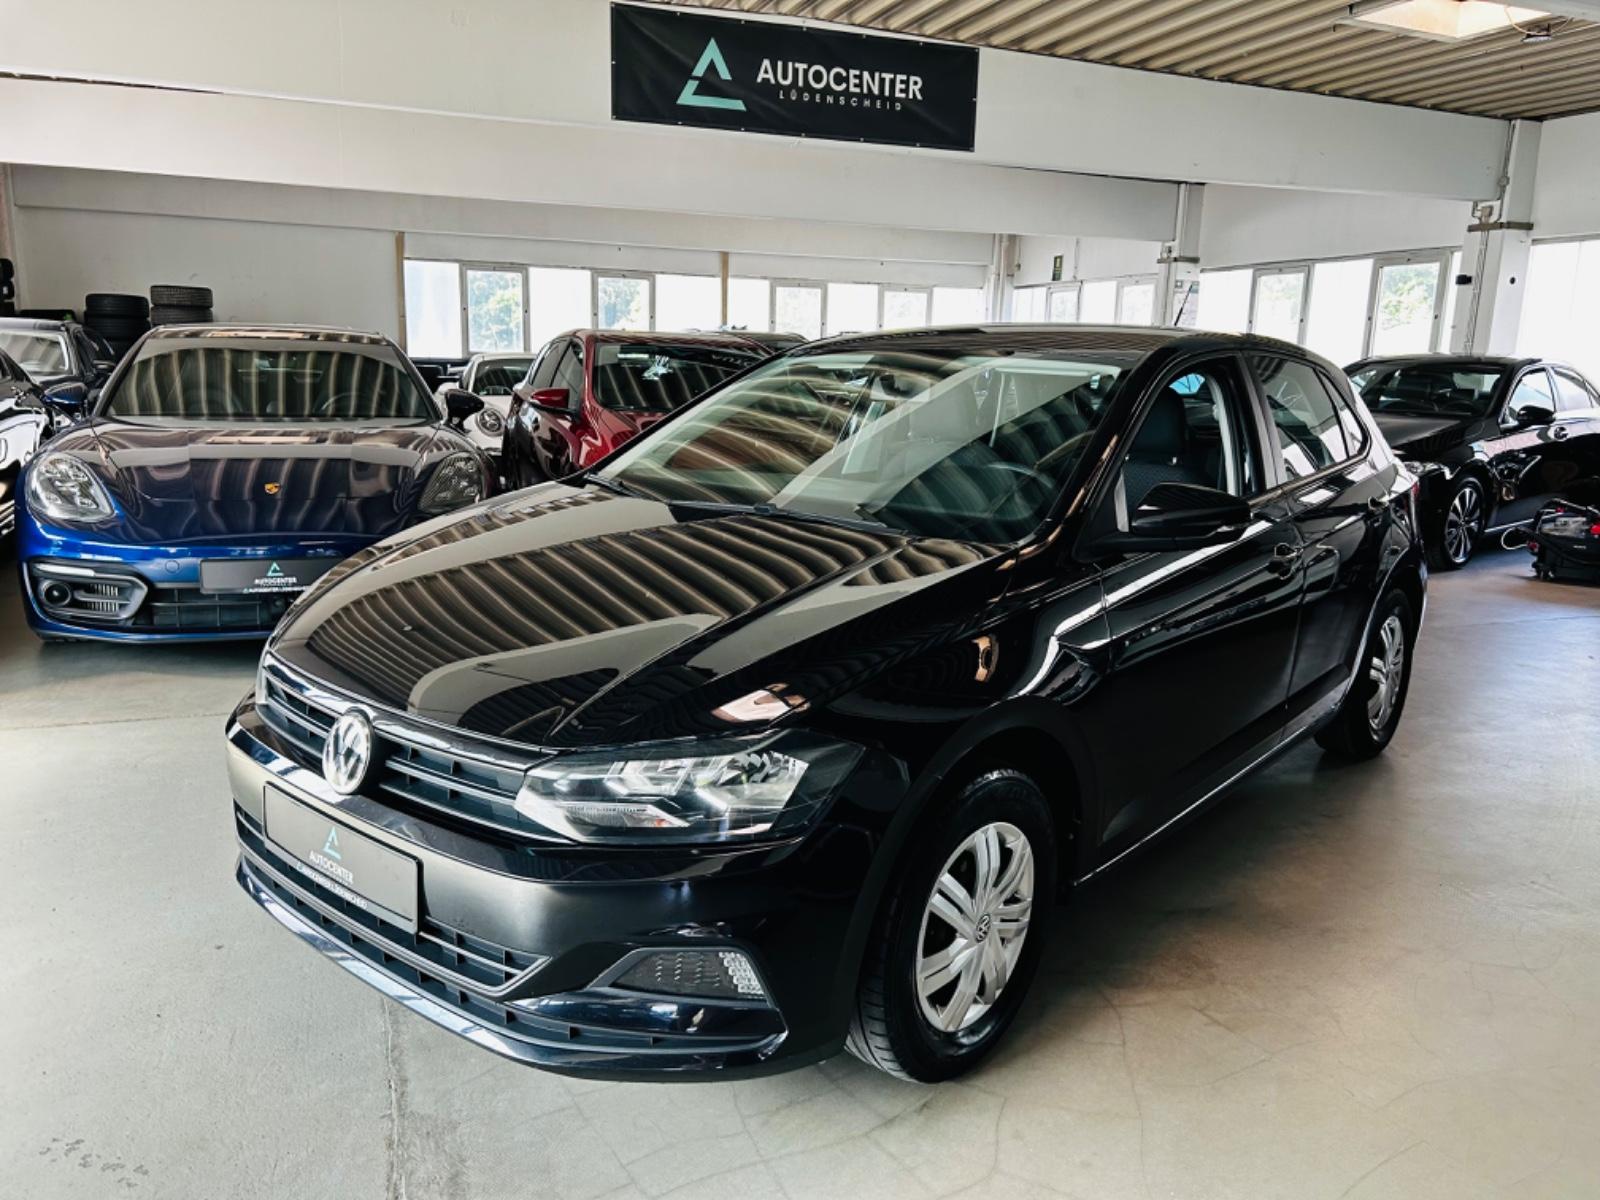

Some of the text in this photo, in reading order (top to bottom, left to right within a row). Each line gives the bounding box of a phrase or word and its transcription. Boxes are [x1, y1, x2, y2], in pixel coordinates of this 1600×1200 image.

[756, 58, 923, 100] AUTOCENTER
[778, 89, 901, 111] LÜDENSCHEID
[309, 850, 354, 885] AUTOCENTER
